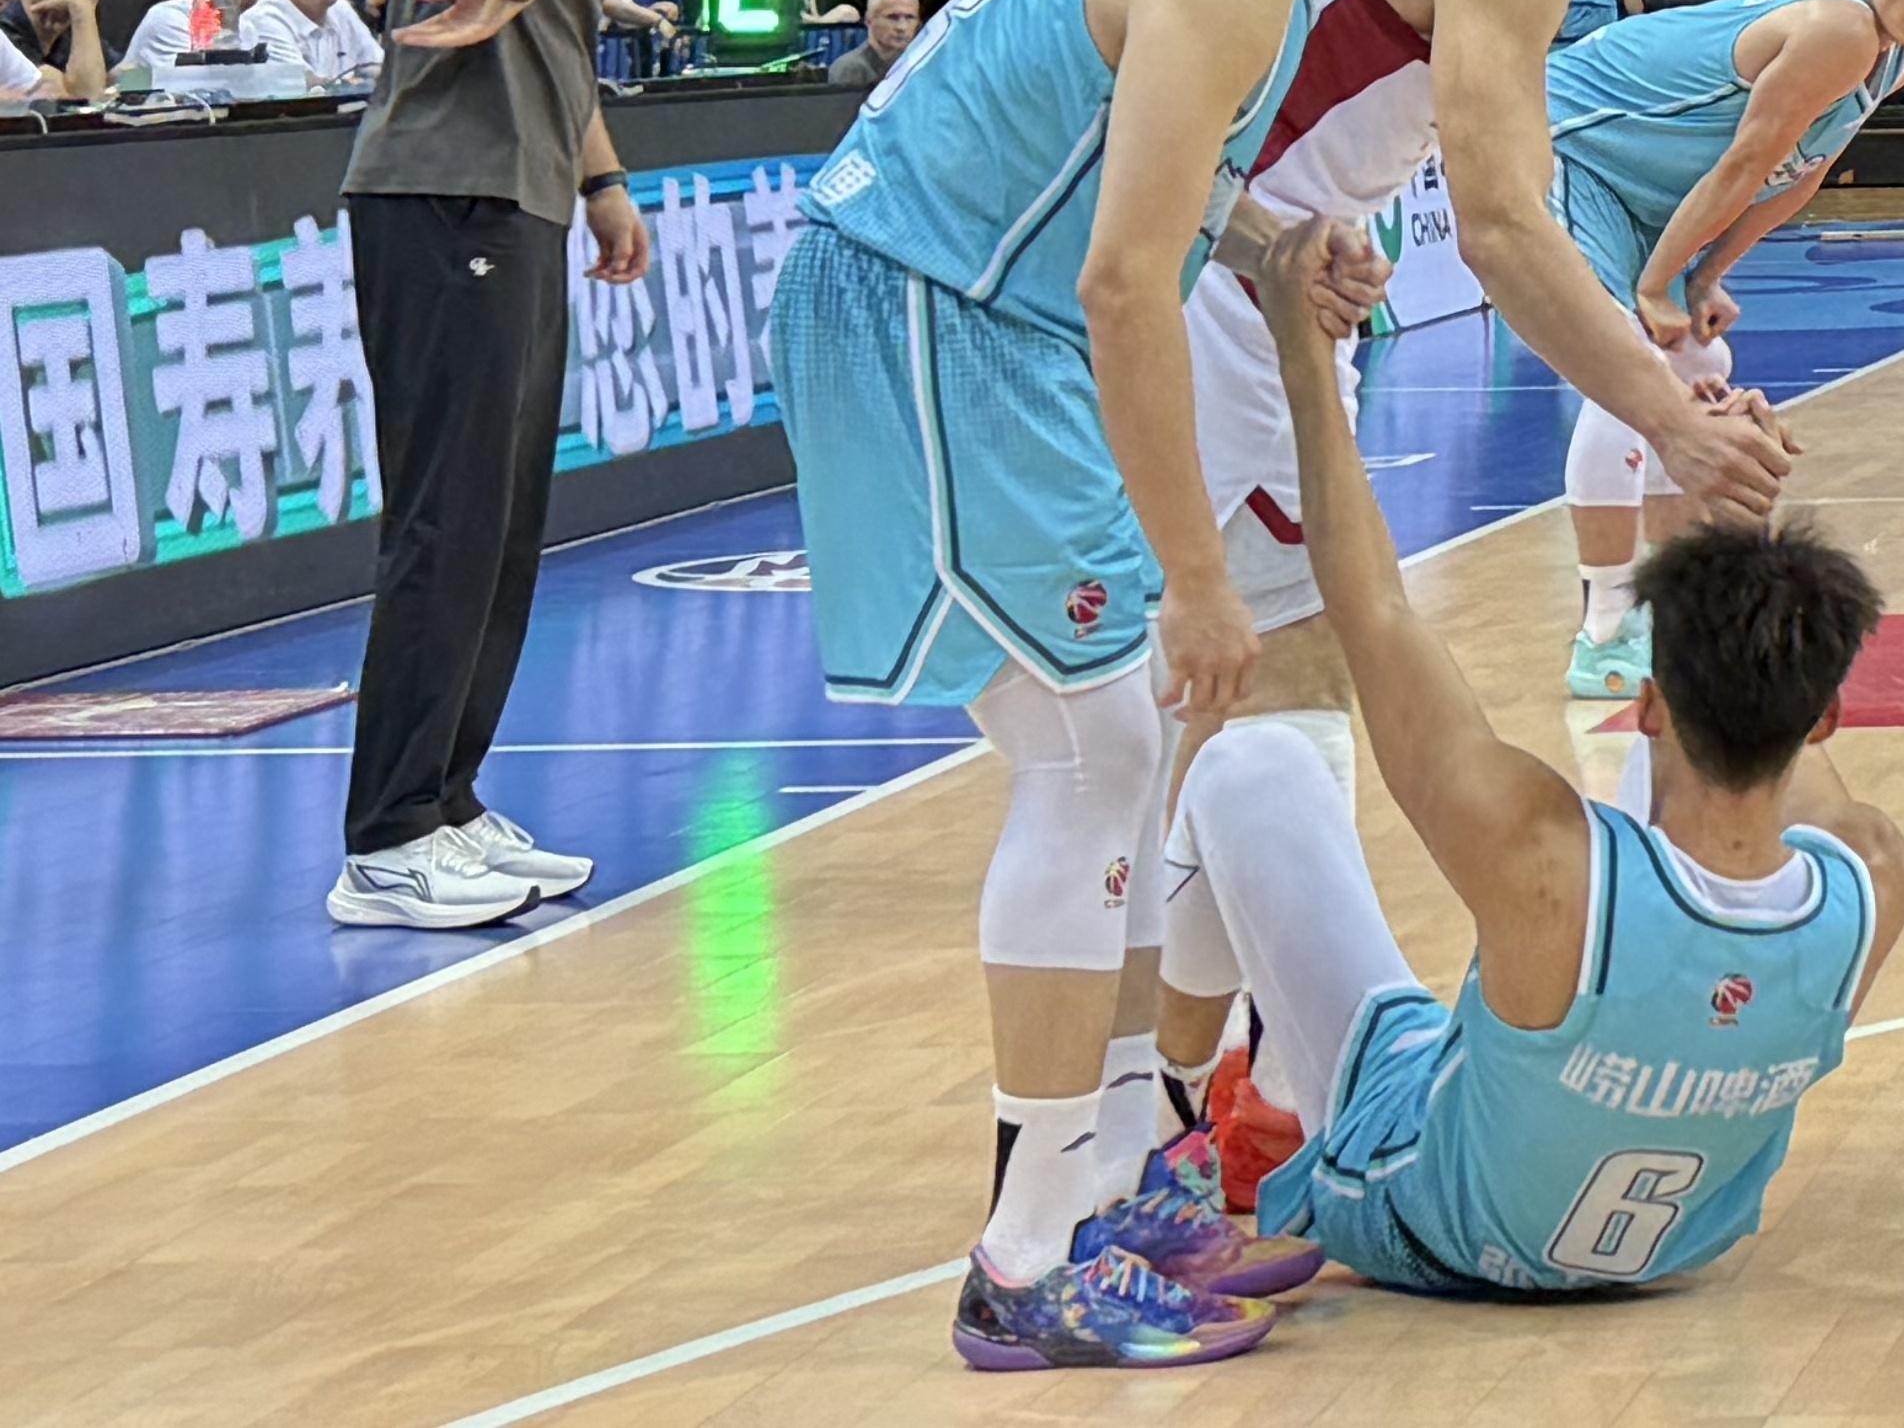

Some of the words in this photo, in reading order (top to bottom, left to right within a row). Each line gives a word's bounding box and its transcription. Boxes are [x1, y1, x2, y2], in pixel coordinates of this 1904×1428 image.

[1559, 1043, 1820, 1119] 崂山啤酒
[1544, 1147, 1704, 1283] 6
